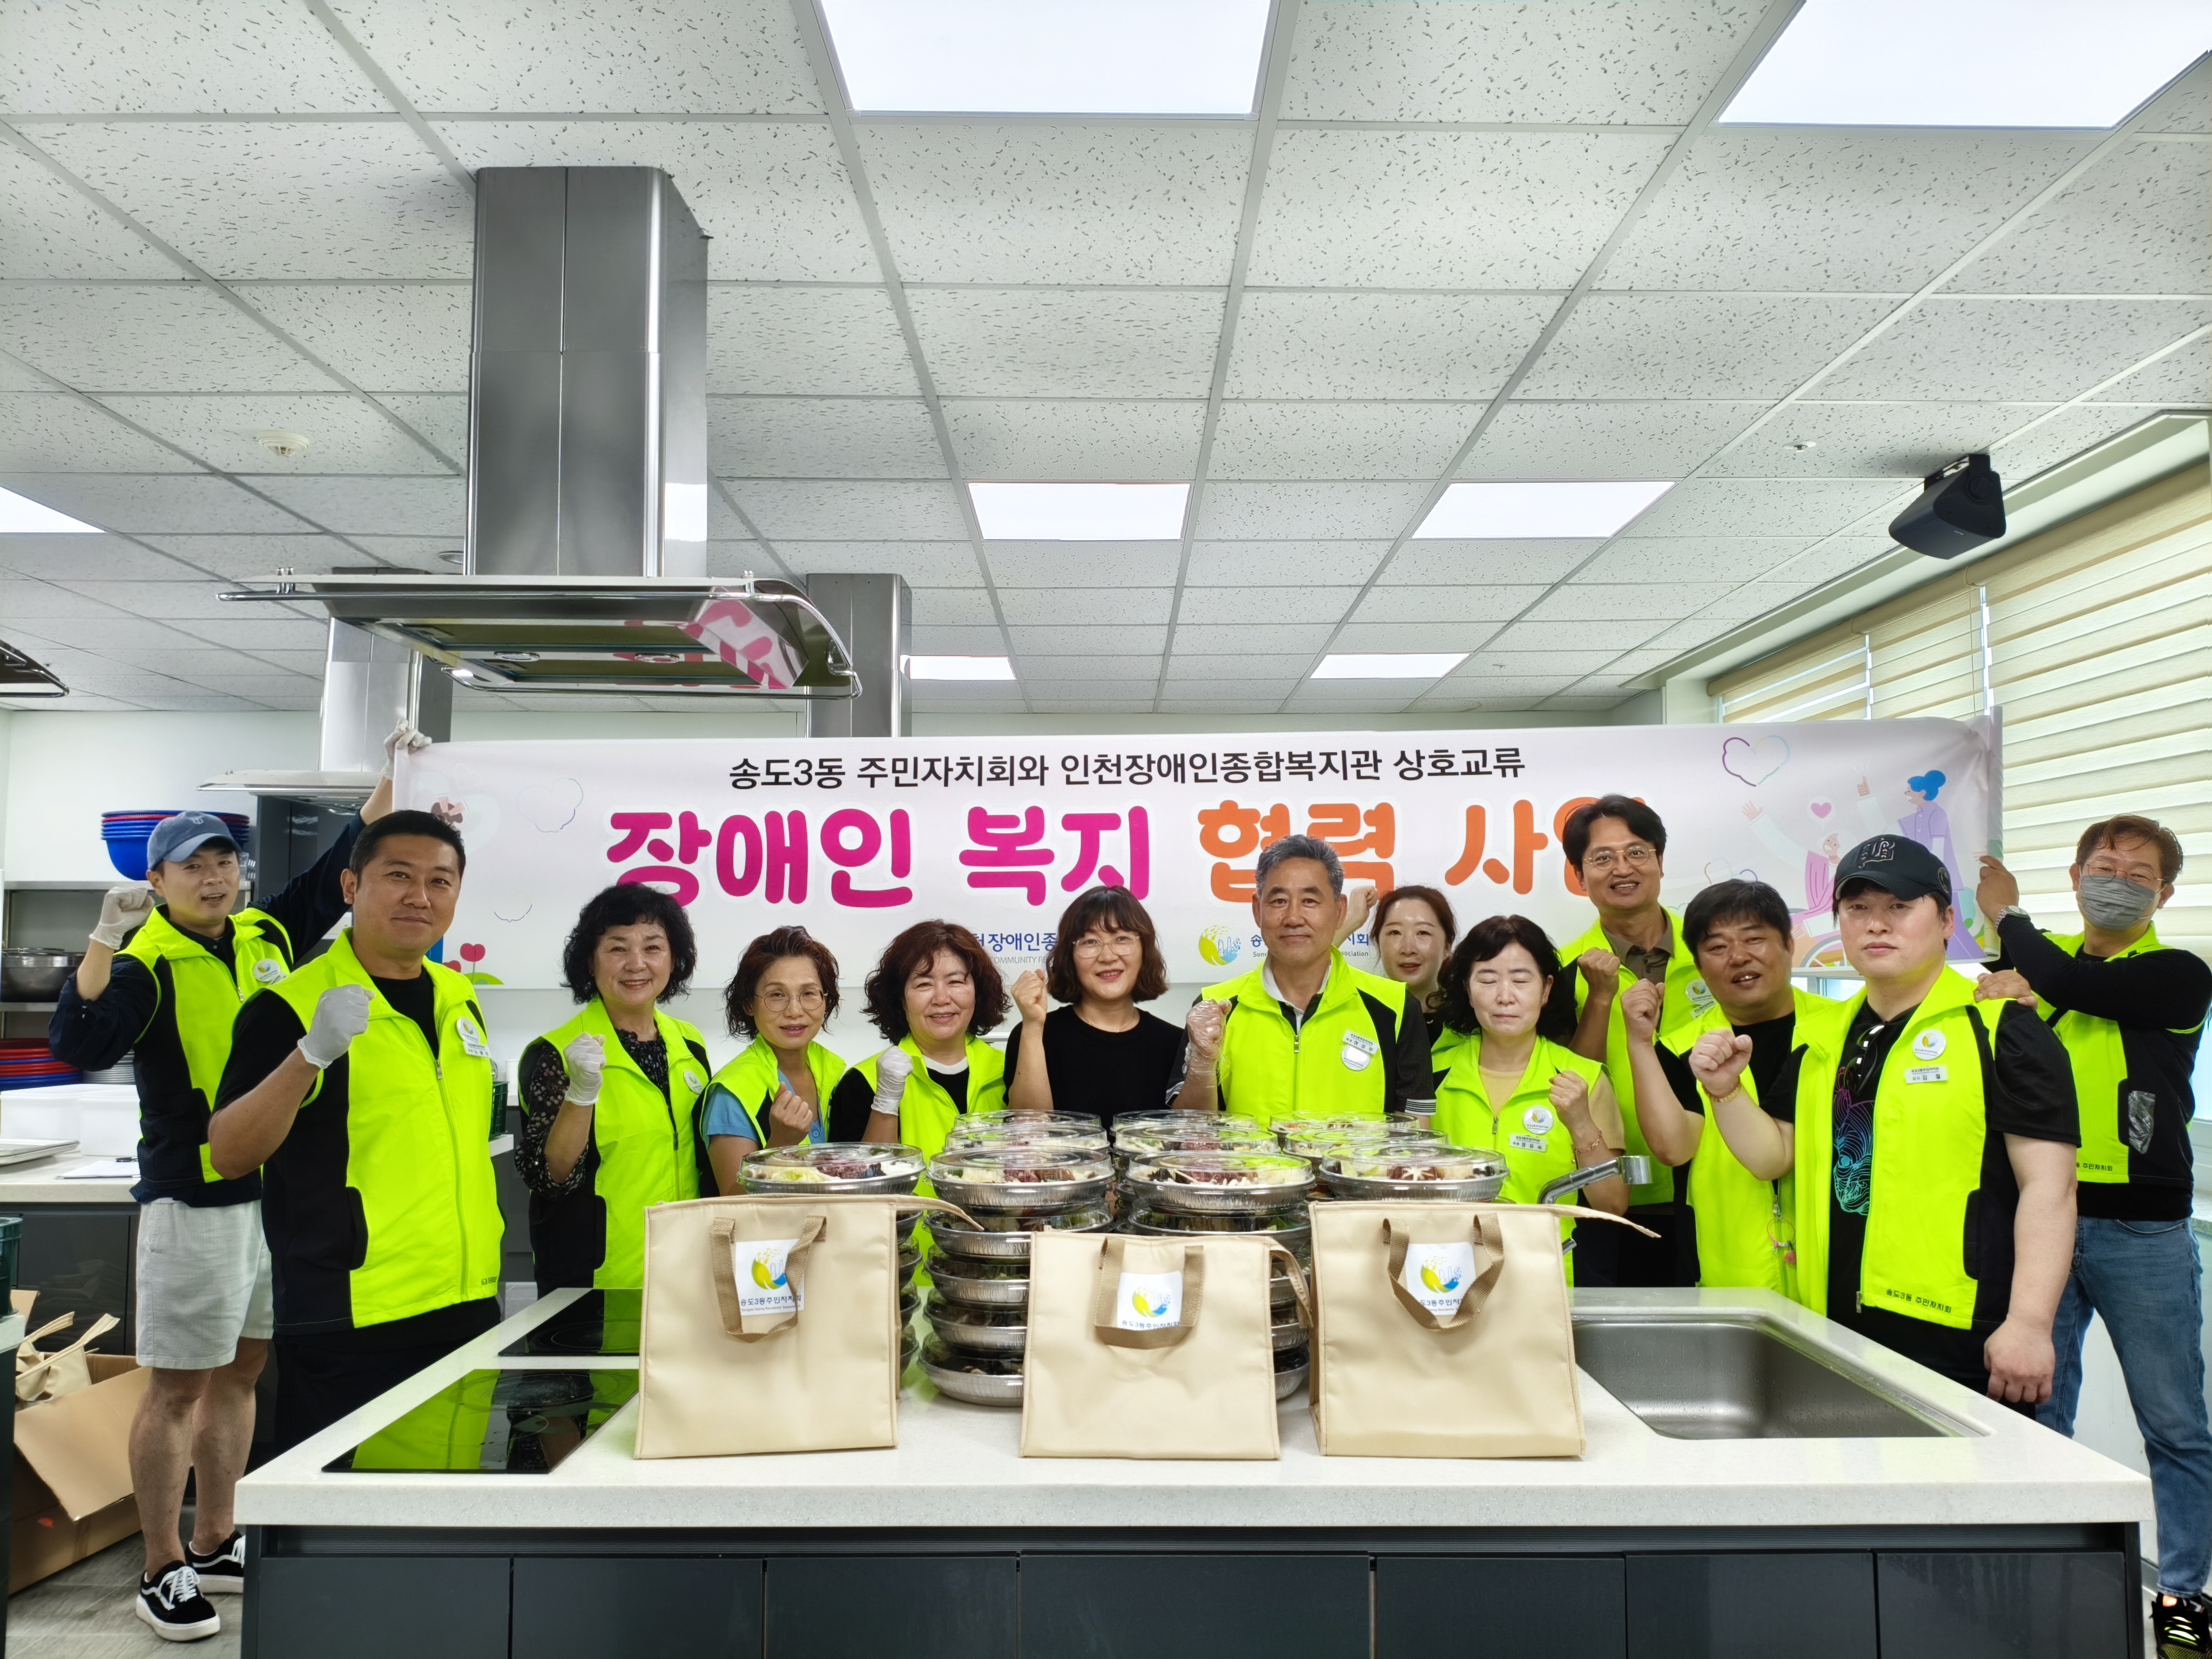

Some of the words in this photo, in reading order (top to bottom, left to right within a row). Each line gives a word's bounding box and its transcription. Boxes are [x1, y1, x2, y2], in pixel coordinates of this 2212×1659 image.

[729, 757, 846, 790] 송도3동
[857, 755, 1049, 787] 주민자치회와
[1061, 750, 1382, 785] 인천장애인종합복지관
[1393, 747, 1526, 781] 상호교류
[606, 810, 913, 908] 장애인
[959, 805, 1151, 907] 복지
[1197, 800, 1395, 903] 협력
[2083, 1163, 2113, 1171] 주민자치회
[1886, 1289, 1912, 1301] 송도3동
[1915, 1296, 1952, 1313] 주민자치회
